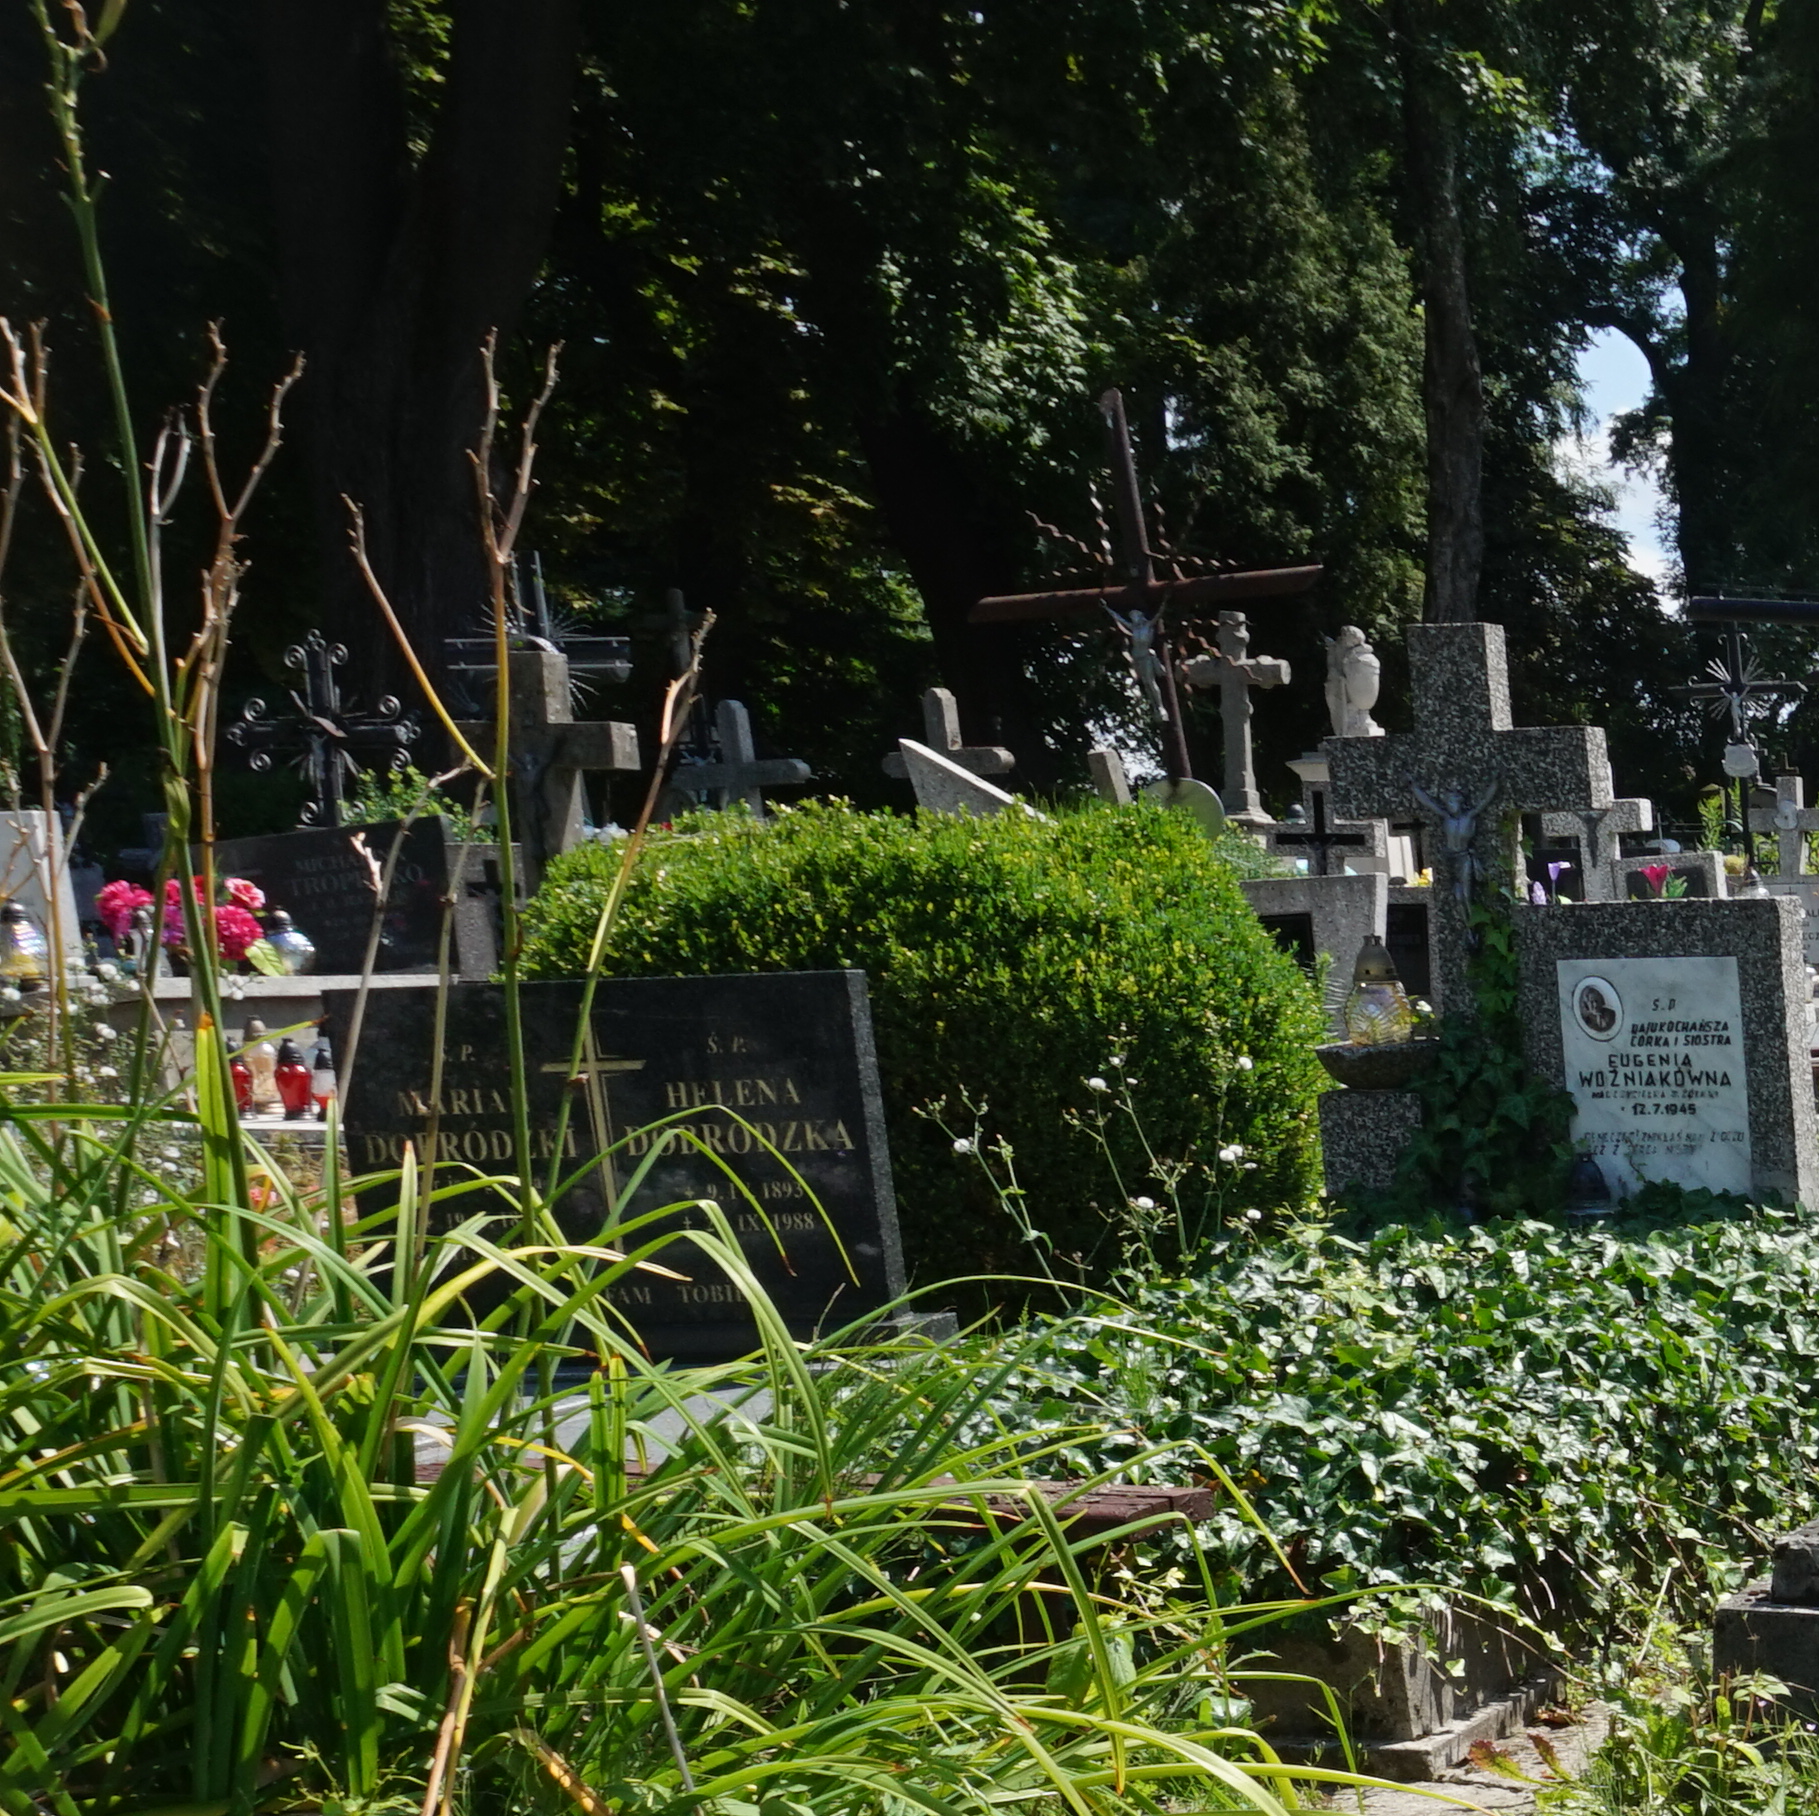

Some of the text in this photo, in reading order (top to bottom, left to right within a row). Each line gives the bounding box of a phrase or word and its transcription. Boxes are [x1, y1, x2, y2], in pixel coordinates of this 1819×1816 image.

[1682, 1034, 1732, 1047] SIOSTRA
[1607, 1053, 1693, 1069] EUGENIA
[664, 1077, 803, 1108] HELENA
